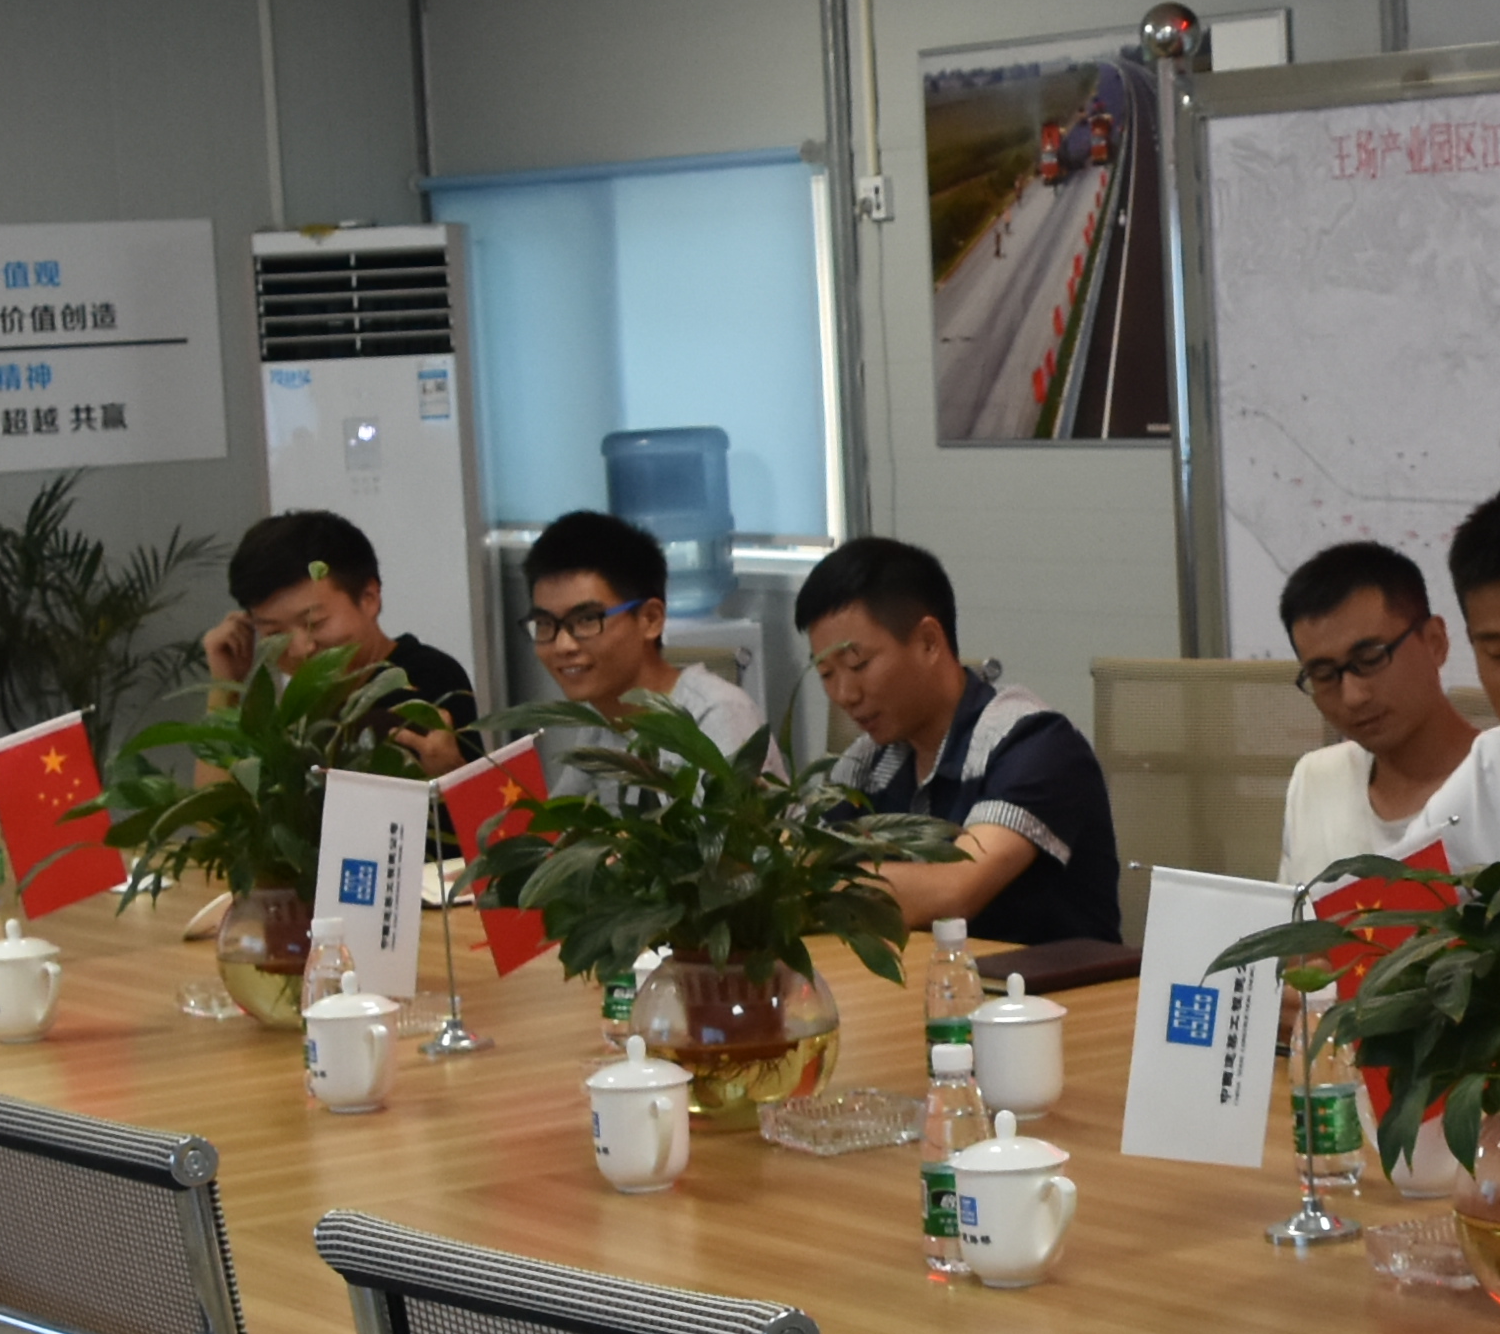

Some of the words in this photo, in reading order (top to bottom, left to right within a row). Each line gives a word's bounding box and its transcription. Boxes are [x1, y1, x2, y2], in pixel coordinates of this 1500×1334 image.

[0, 303, 118, 335] 价值创造
[1, 406, 60, 436] 超越
[70, 402, 128, 433] 共赢
